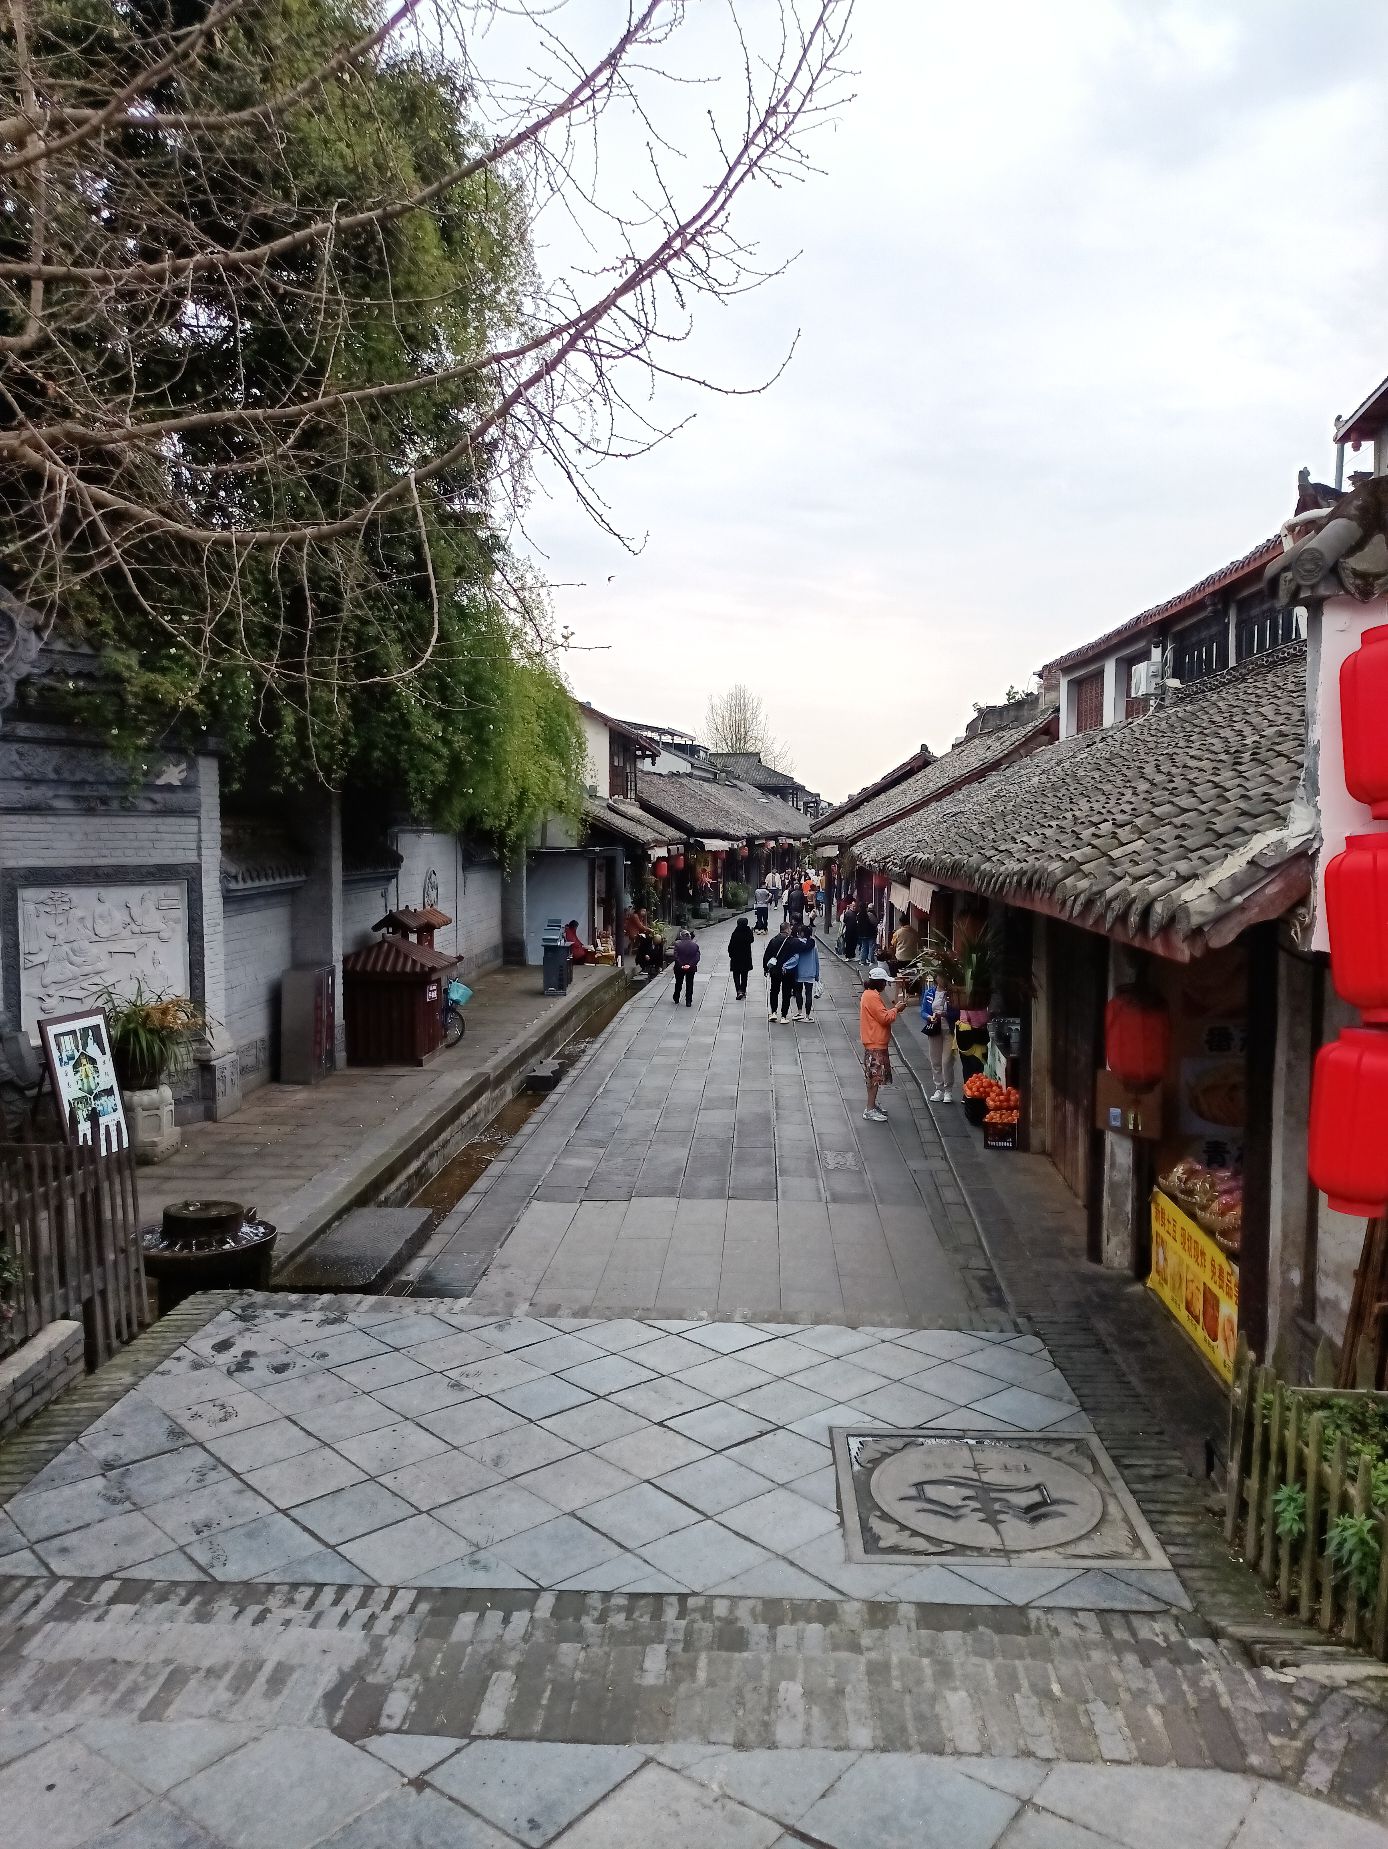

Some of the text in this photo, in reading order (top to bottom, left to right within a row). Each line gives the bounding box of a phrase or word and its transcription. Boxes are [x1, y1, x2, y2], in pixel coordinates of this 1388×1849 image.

[1154, 1203, 1178, 1243] 新鲜土豆
[1180, 1227, 1207, 1272] 现切现炸
